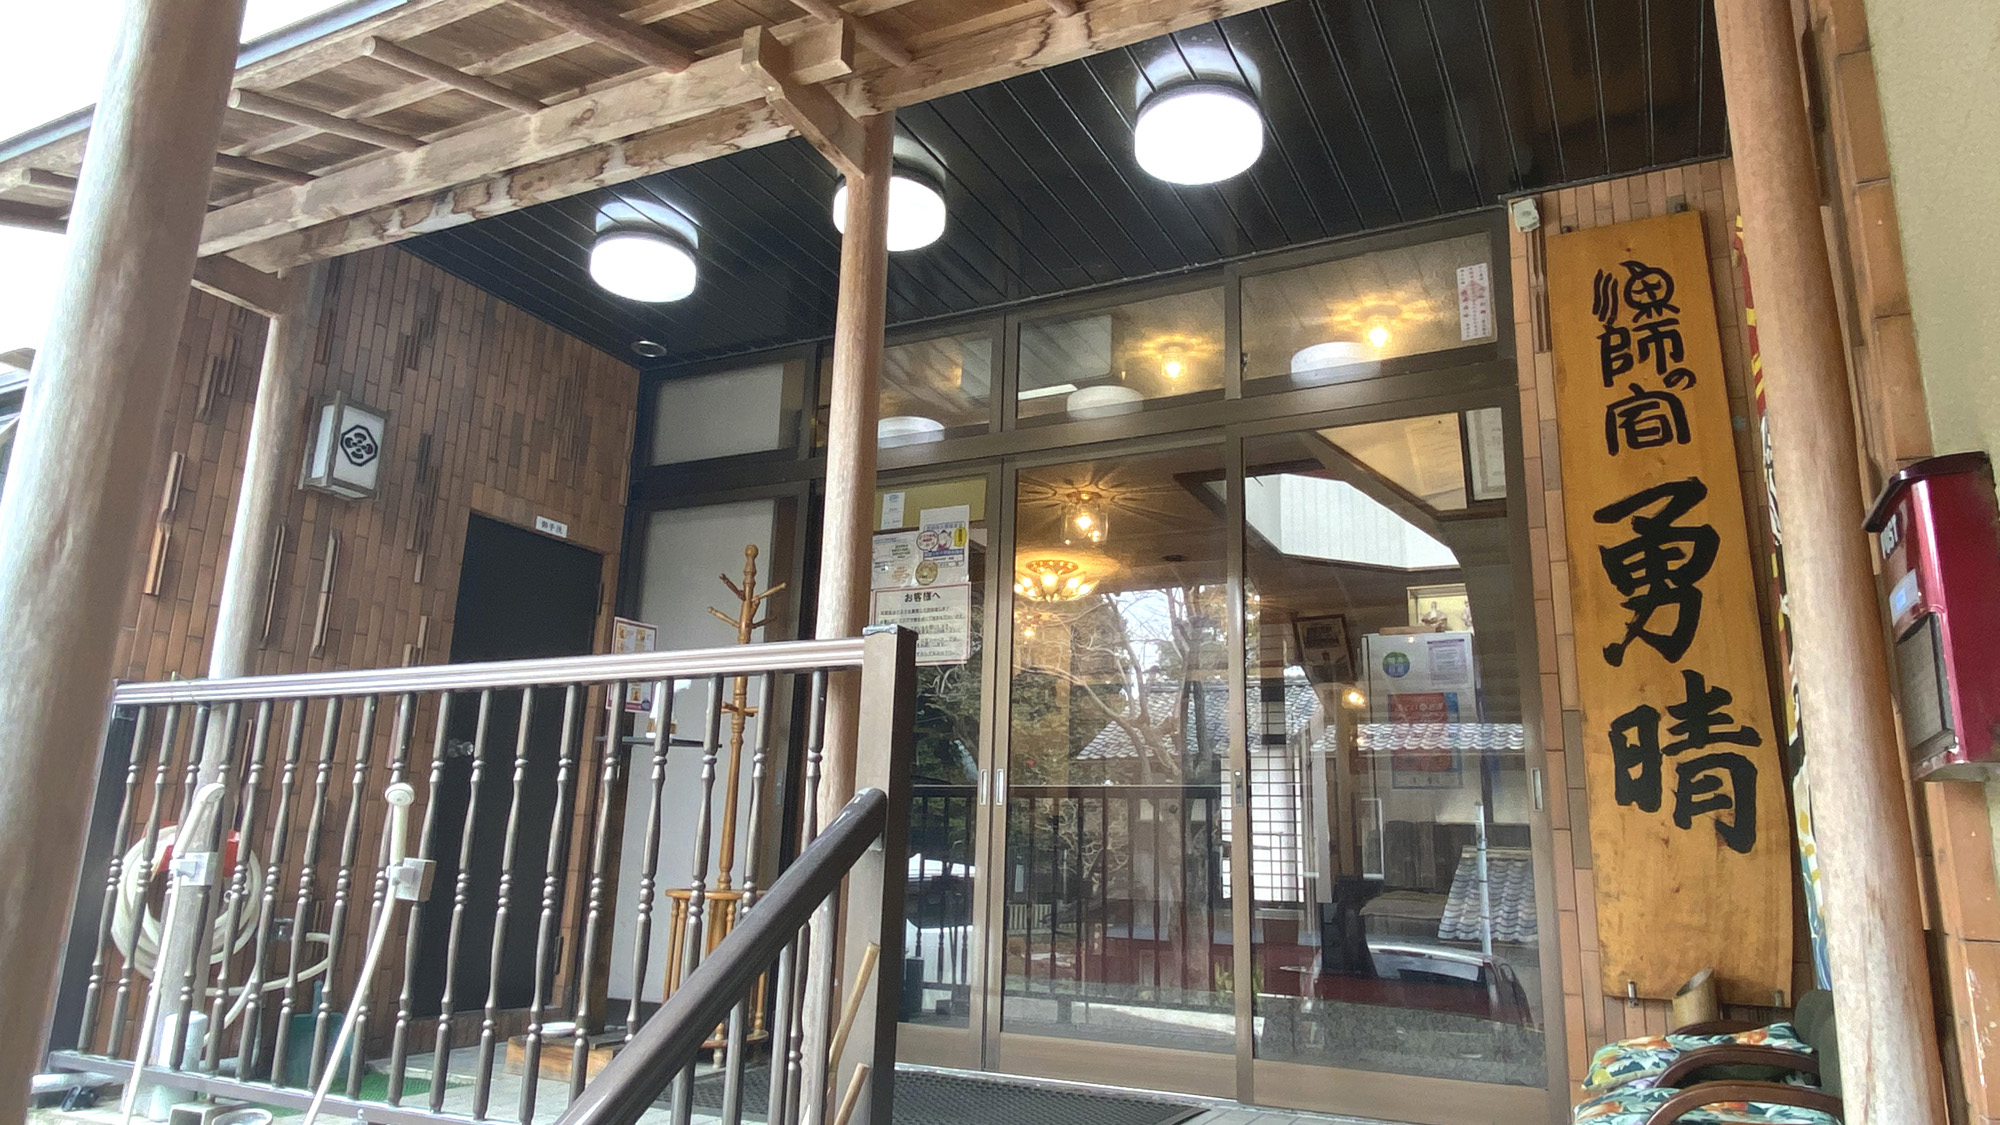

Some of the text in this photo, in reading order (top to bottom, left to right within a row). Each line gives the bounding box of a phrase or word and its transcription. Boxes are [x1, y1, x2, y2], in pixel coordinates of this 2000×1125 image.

[904, 591, 941, 603] お客様へ
[1593, 476, 1763, 855] 勇晴
